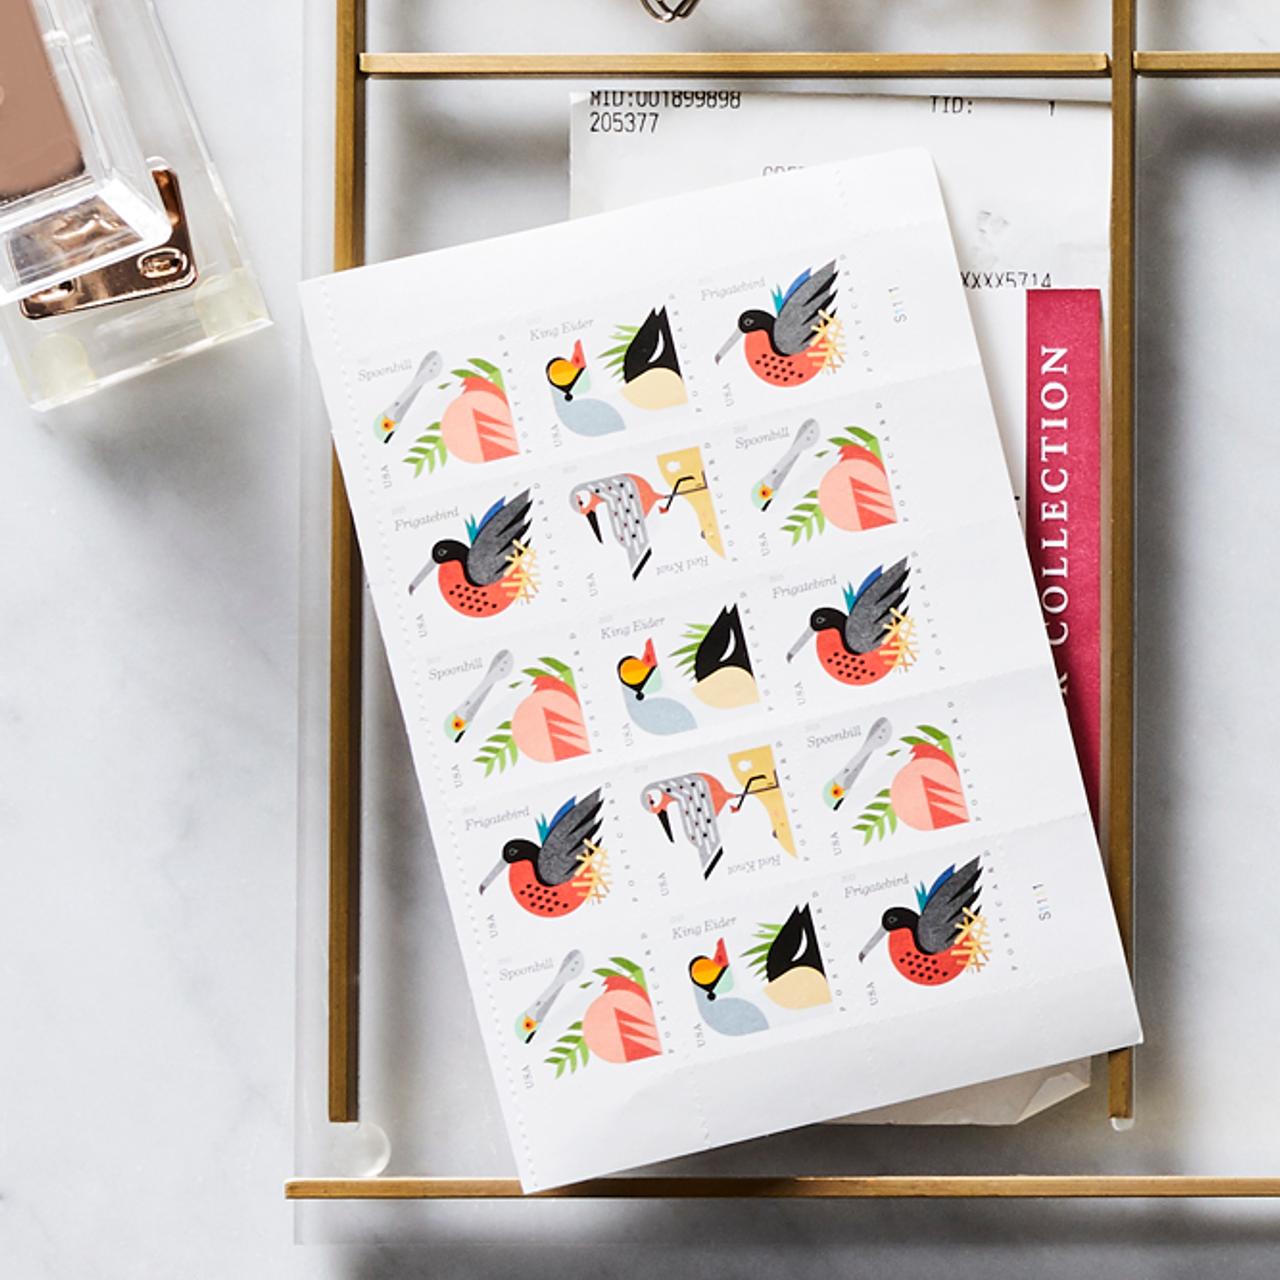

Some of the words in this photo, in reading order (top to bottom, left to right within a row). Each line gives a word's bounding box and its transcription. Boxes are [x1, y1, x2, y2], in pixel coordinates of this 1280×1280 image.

[929, 95, 975, 115] TID:
[589, 111, 660, 133] 205377
[700, 277, 767, 302] Frigatebird
[529, 324, 558, 343] King
[559, 316, 594, 334] Eider
[357, 358, 413, 384] Spoonbill
[735, 426, 790, 450] Spoonbill
[1040, 345, 1070, 646] COLLECTION
[394, 506, 460, 532] Frigatebird
[772, 574, 838, 600] Frigatebird
[600, 623, 628, 641] King
[629, 614, 665, 632] Eider
[428, 657, 483, 681] Spoonbill
[806, 725, 862, 749] Spoonbill
[465, 805, 531, 831] Frigatebird
[843, 873, 910, 899] Frigatebird
[671, 924, 699, 941] King
[700, 915, 737, 933] Eider
[498, 958, 554, 982] Spoonbill
